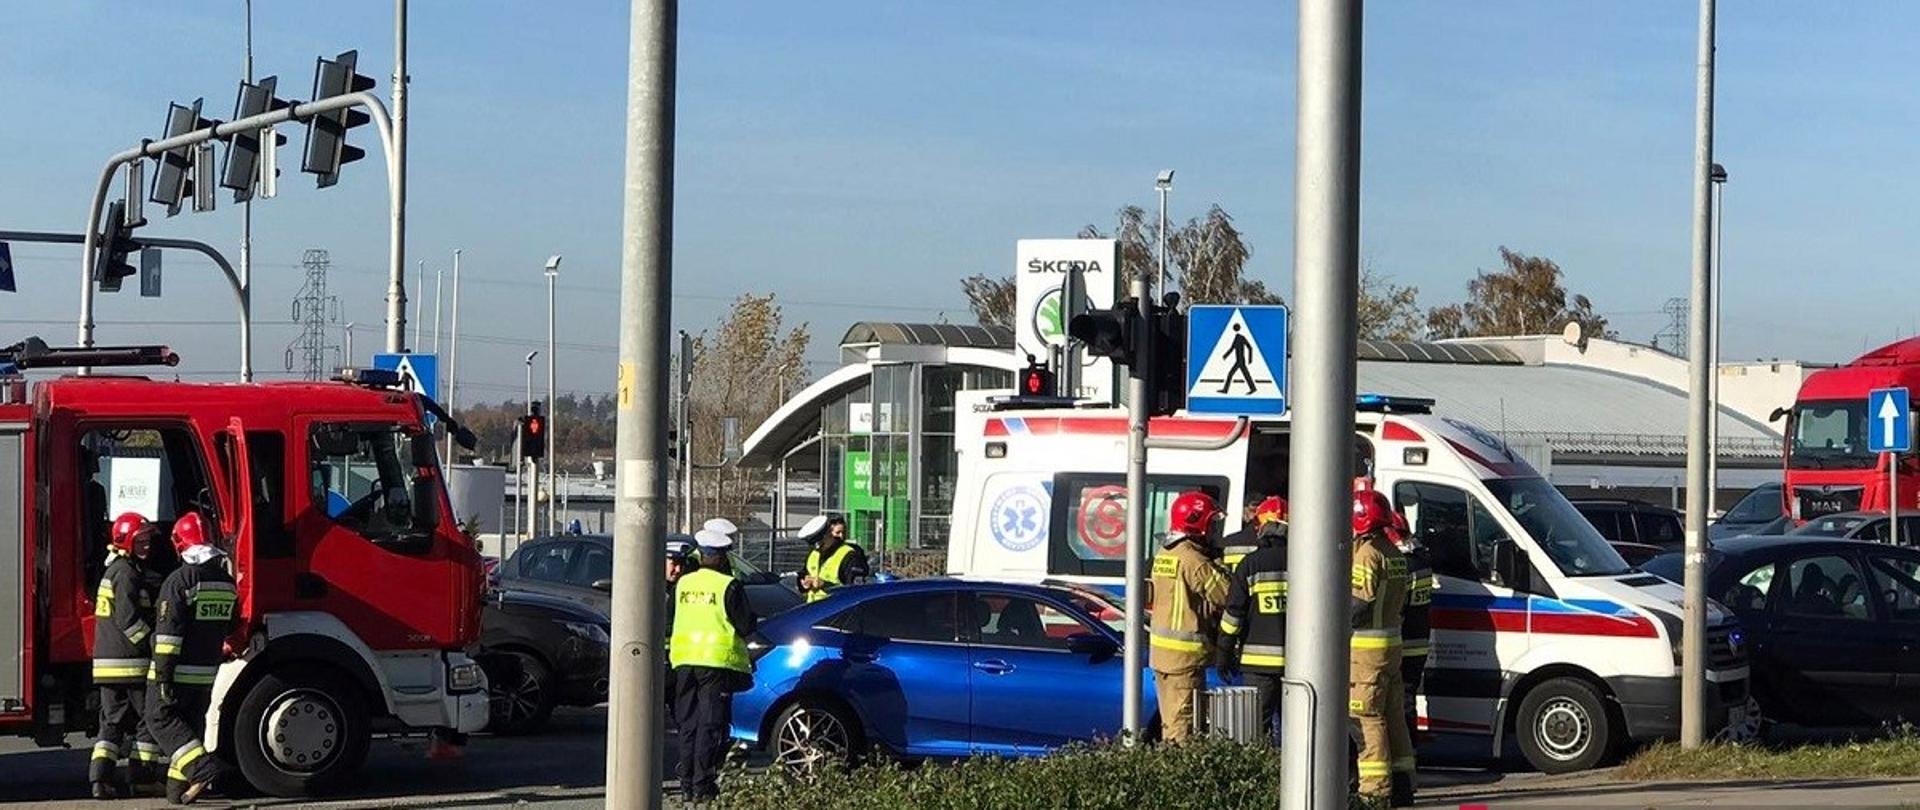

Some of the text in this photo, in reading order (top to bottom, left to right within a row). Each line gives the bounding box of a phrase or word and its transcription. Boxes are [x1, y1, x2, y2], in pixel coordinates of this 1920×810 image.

[1028, 257, 1102, 273] ŠKODA
[1811, 500, 1842, 512] MAN
[1263, 595, 1288, 610] STR
